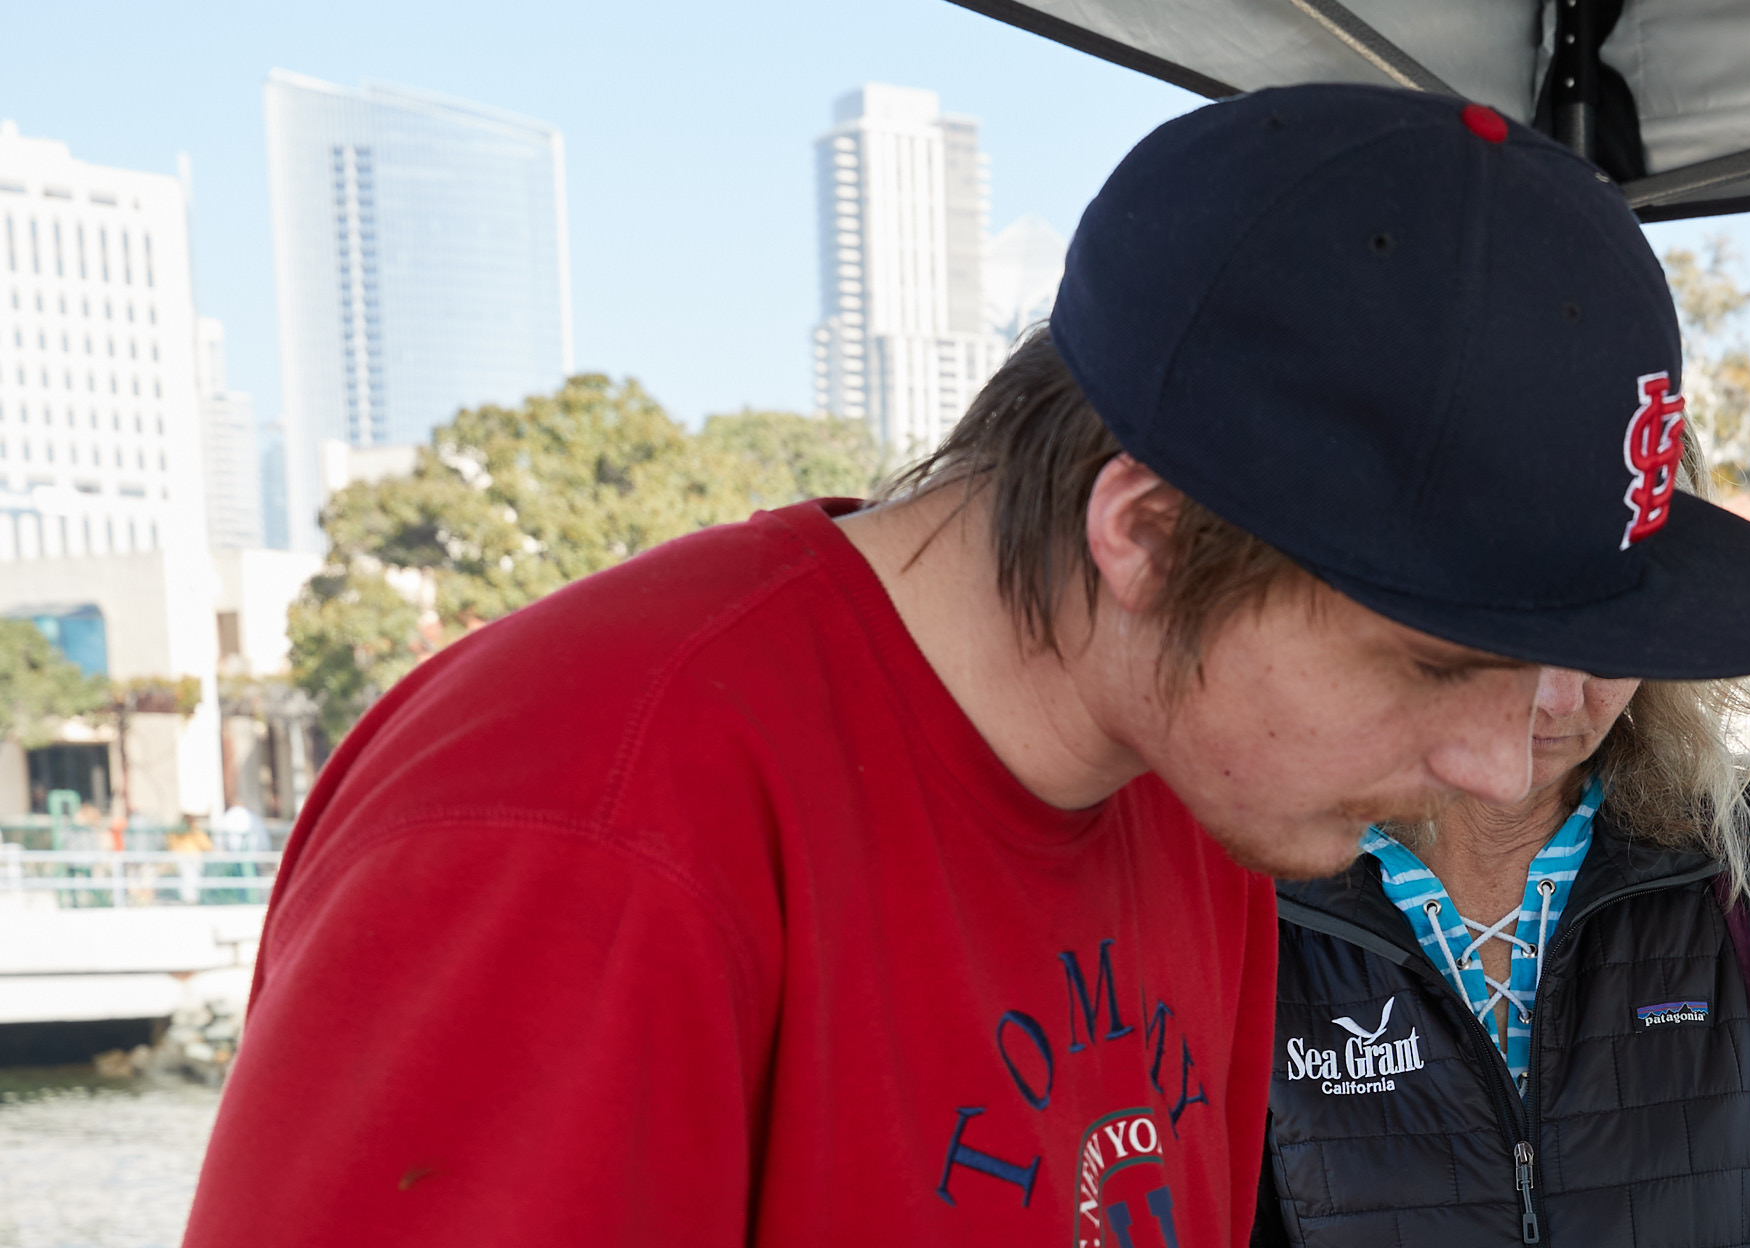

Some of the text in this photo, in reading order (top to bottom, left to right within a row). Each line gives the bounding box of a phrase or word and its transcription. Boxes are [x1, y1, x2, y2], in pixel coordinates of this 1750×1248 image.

[1644, 1011, 1705, 1027] patagonia
[1287, 1026, 1425, 1081] Sea Grant
[1321, 1077, 1396, 1095] California
[1079, 1132, 1105, 1229] NEW
[1104, 1117, 1164, 1159] YO
